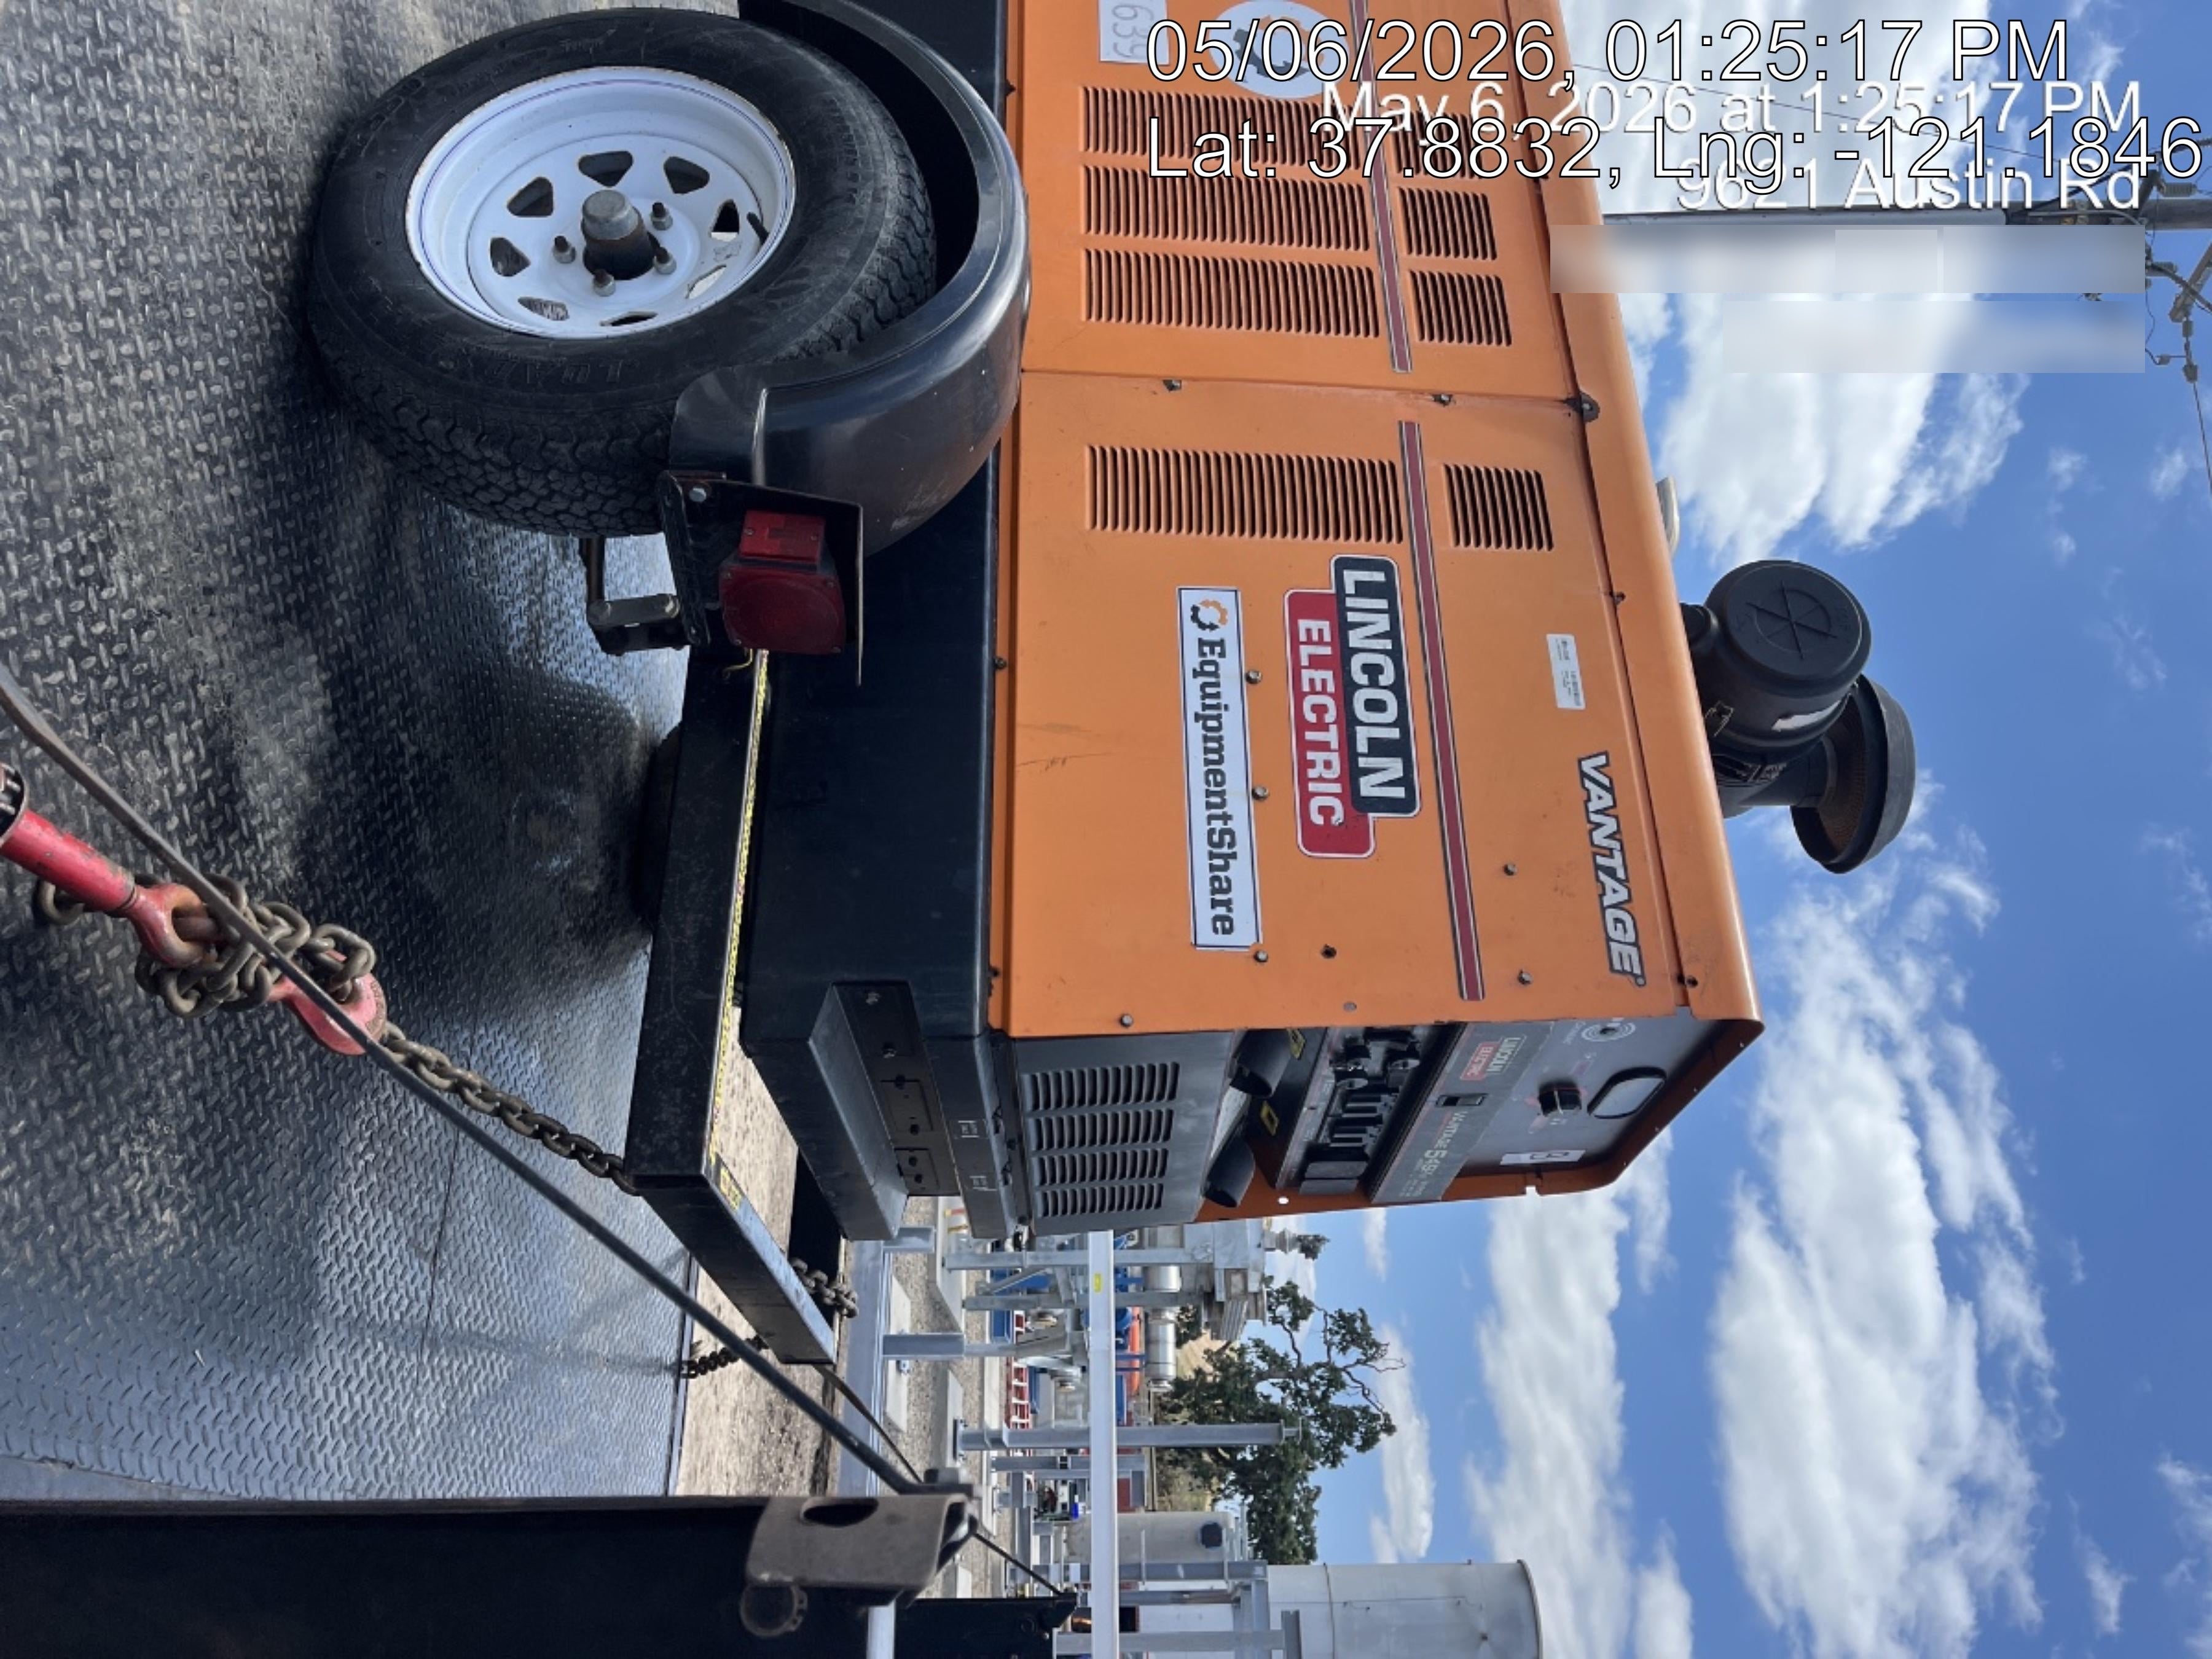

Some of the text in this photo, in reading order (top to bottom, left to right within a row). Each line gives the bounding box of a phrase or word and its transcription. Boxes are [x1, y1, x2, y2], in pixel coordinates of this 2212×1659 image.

[1193, 637, 1237, 935] EquipmentShare
[1297, 618, 1343, 826] ELECTRIC
[1342, 570, 1406, 798] LINCOLN
[1580, 753, 1641, 978] VANTAGE
[1434, 1110, 1469, 1150] VANTAGE
[1466, 1046, 1494, 1077] ELECTRIC
[1486, 1037, 1522, 1072] LINCOLN
